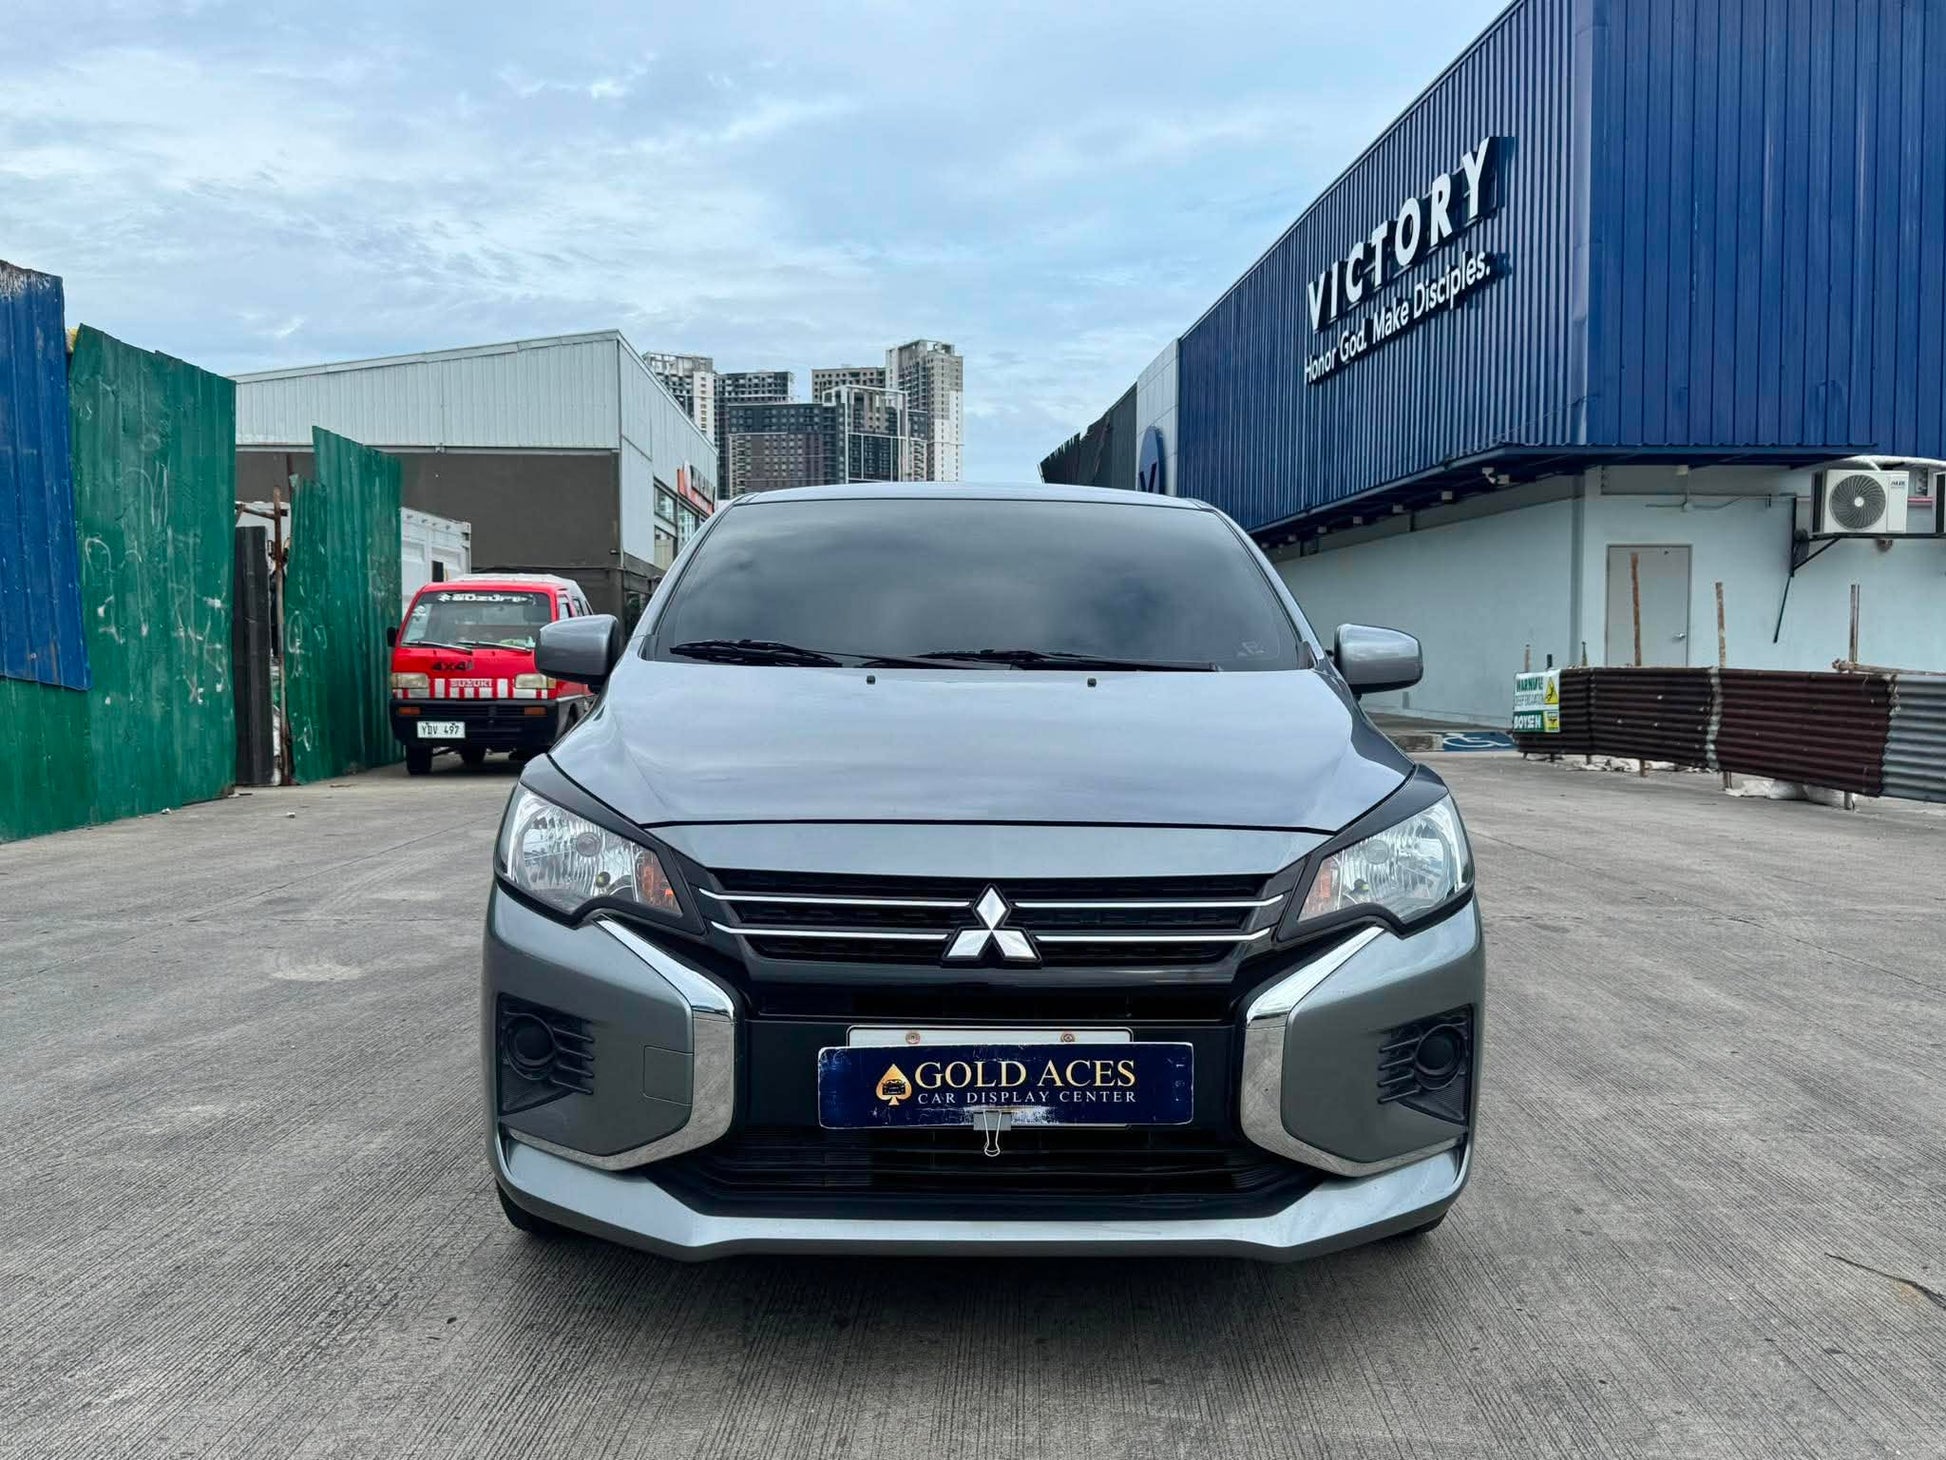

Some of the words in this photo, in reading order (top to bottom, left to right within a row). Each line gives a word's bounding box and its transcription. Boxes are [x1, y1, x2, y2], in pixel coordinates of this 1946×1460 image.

[1308, 137, 1490, 331] VICTORY
[1304, 347, 1337, 384] Honor
[1339, 319, 1367, 362] God.
[1372, 297, 1409, 344] Make
[1413, 250, 1491, 319] Disciples.
[444, 725, 460, 735] 497
[914, 1060, 1027, 1089] GOLD
[1039, 1059, 1136, 1088] ACES
[918, 1093, 956, 1105] CAR
[967, 1092, 1050, 1104] DISPLAY
[1059, 1091, 1137, 1103] CENTER
